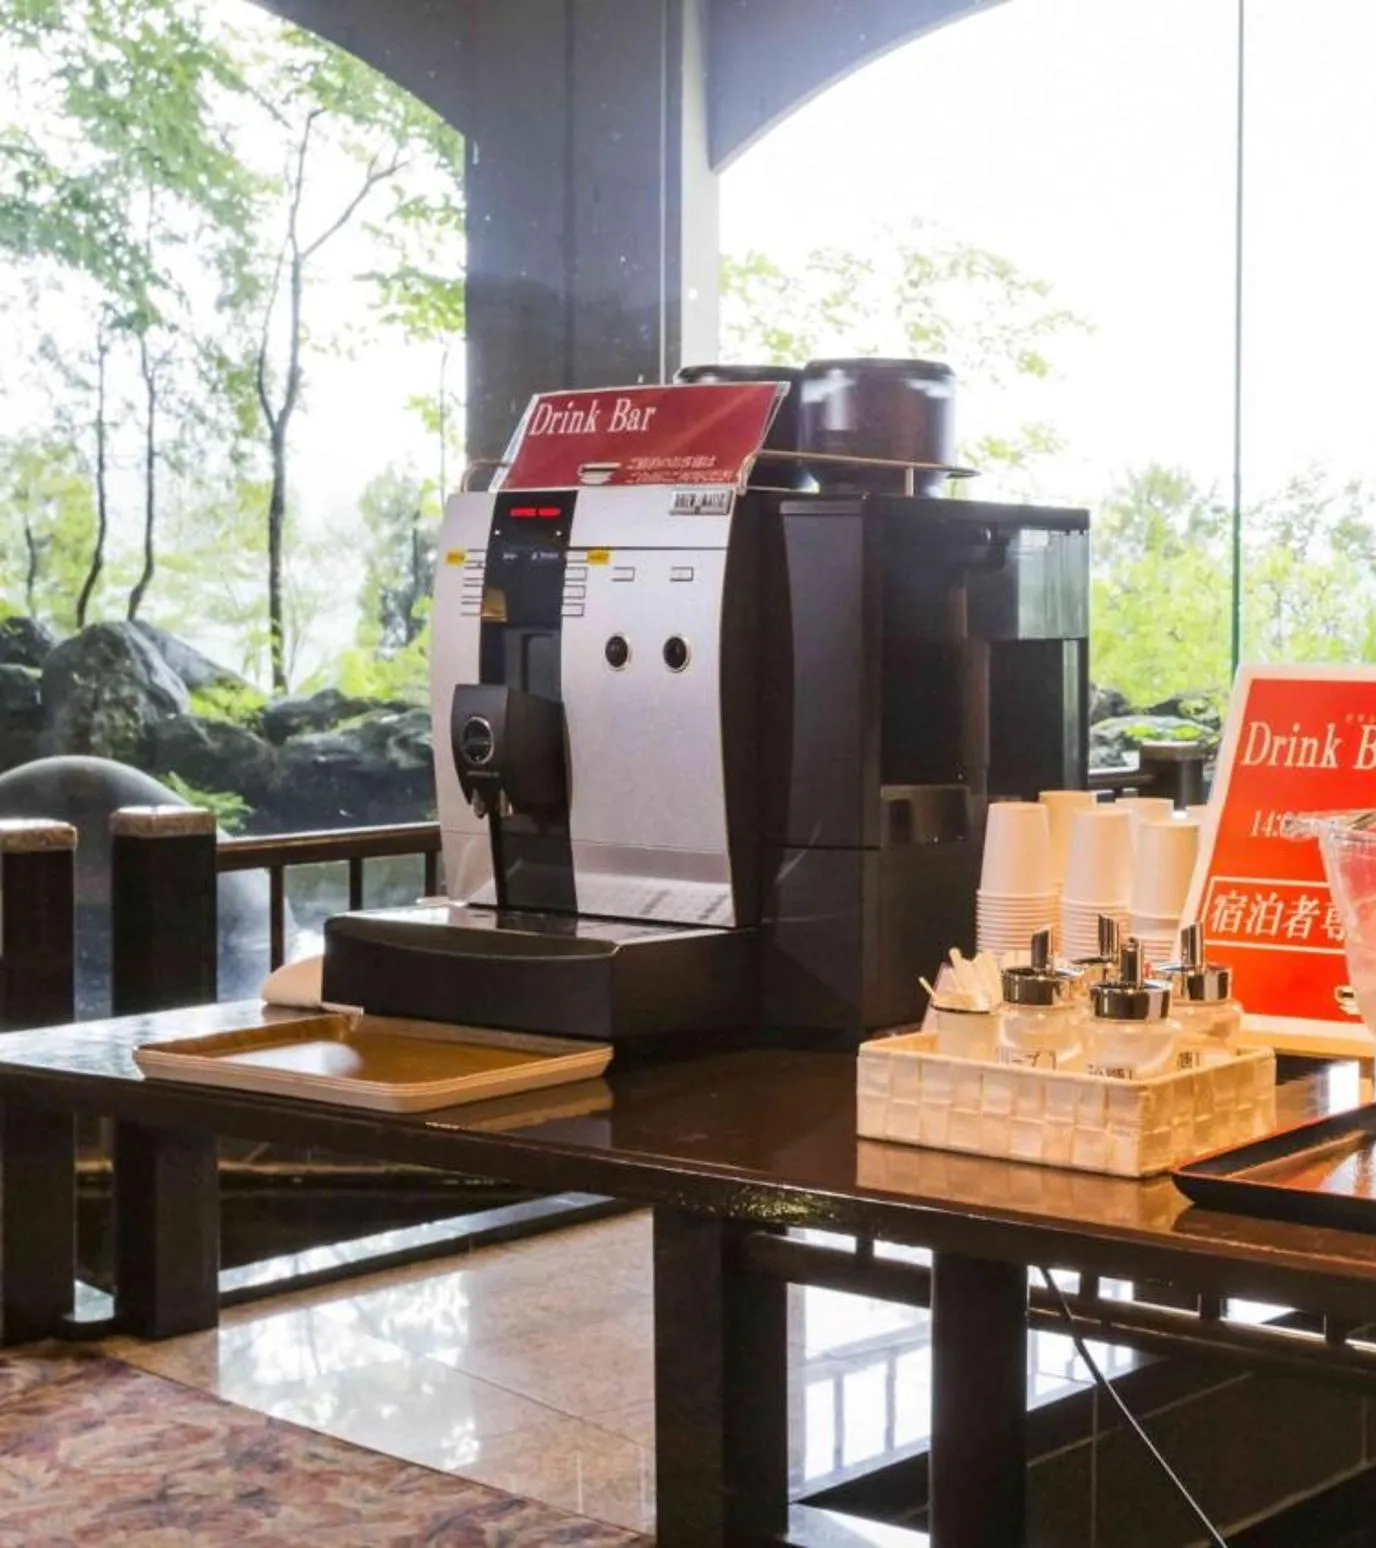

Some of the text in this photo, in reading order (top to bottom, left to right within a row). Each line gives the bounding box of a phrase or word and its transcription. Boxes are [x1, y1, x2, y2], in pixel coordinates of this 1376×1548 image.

[528, 398, 656, 436] Drink Bar
[1242, 721, 1343, 769] Drink
